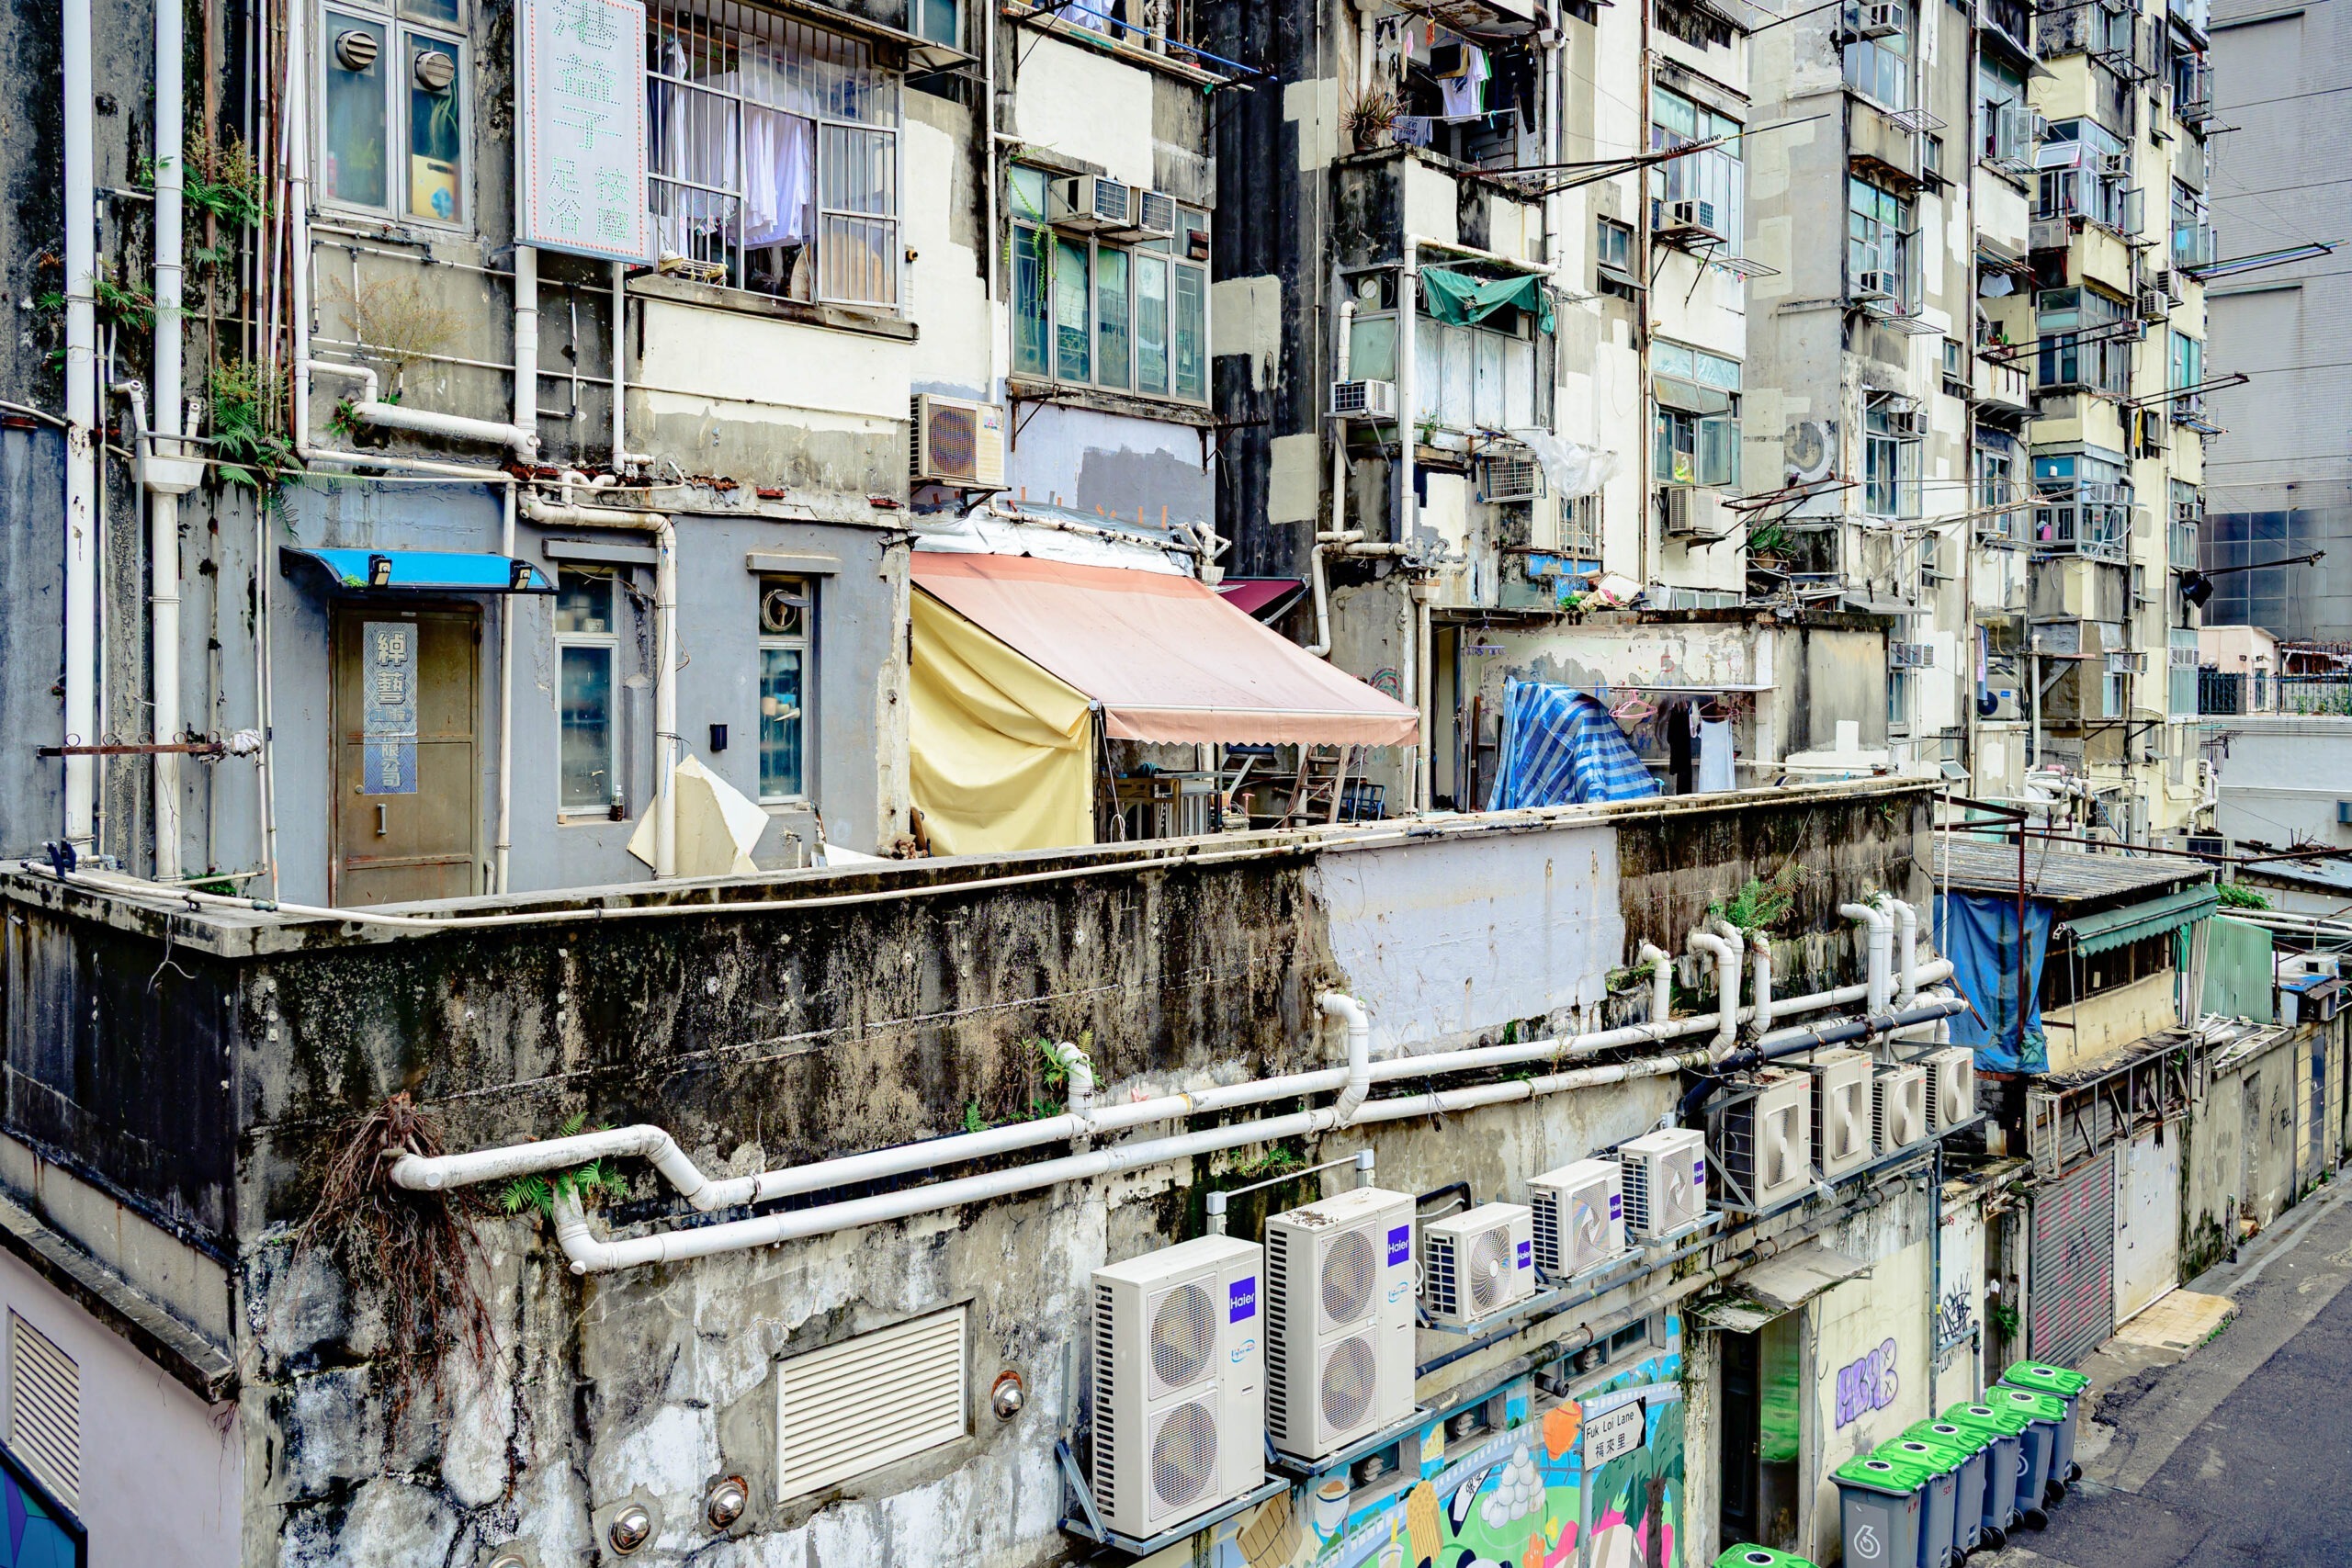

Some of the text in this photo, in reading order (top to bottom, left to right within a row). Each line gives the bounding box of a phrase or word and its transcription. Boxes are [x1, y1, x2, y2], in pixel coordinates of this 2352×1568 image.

[547, 157, 582, 235] 足浴
[594, 166, 631, 242] 按摩
[381, 728, 401, 787] 有限公司
[1388, 1239, 1408, 1255] Haier
[1230, 1292, 1255, 1310] Haier
[1586, 1411, 1634, 1440] Fuk Loi Lane
[1595, 1433, 1626, 1459] 福來里
